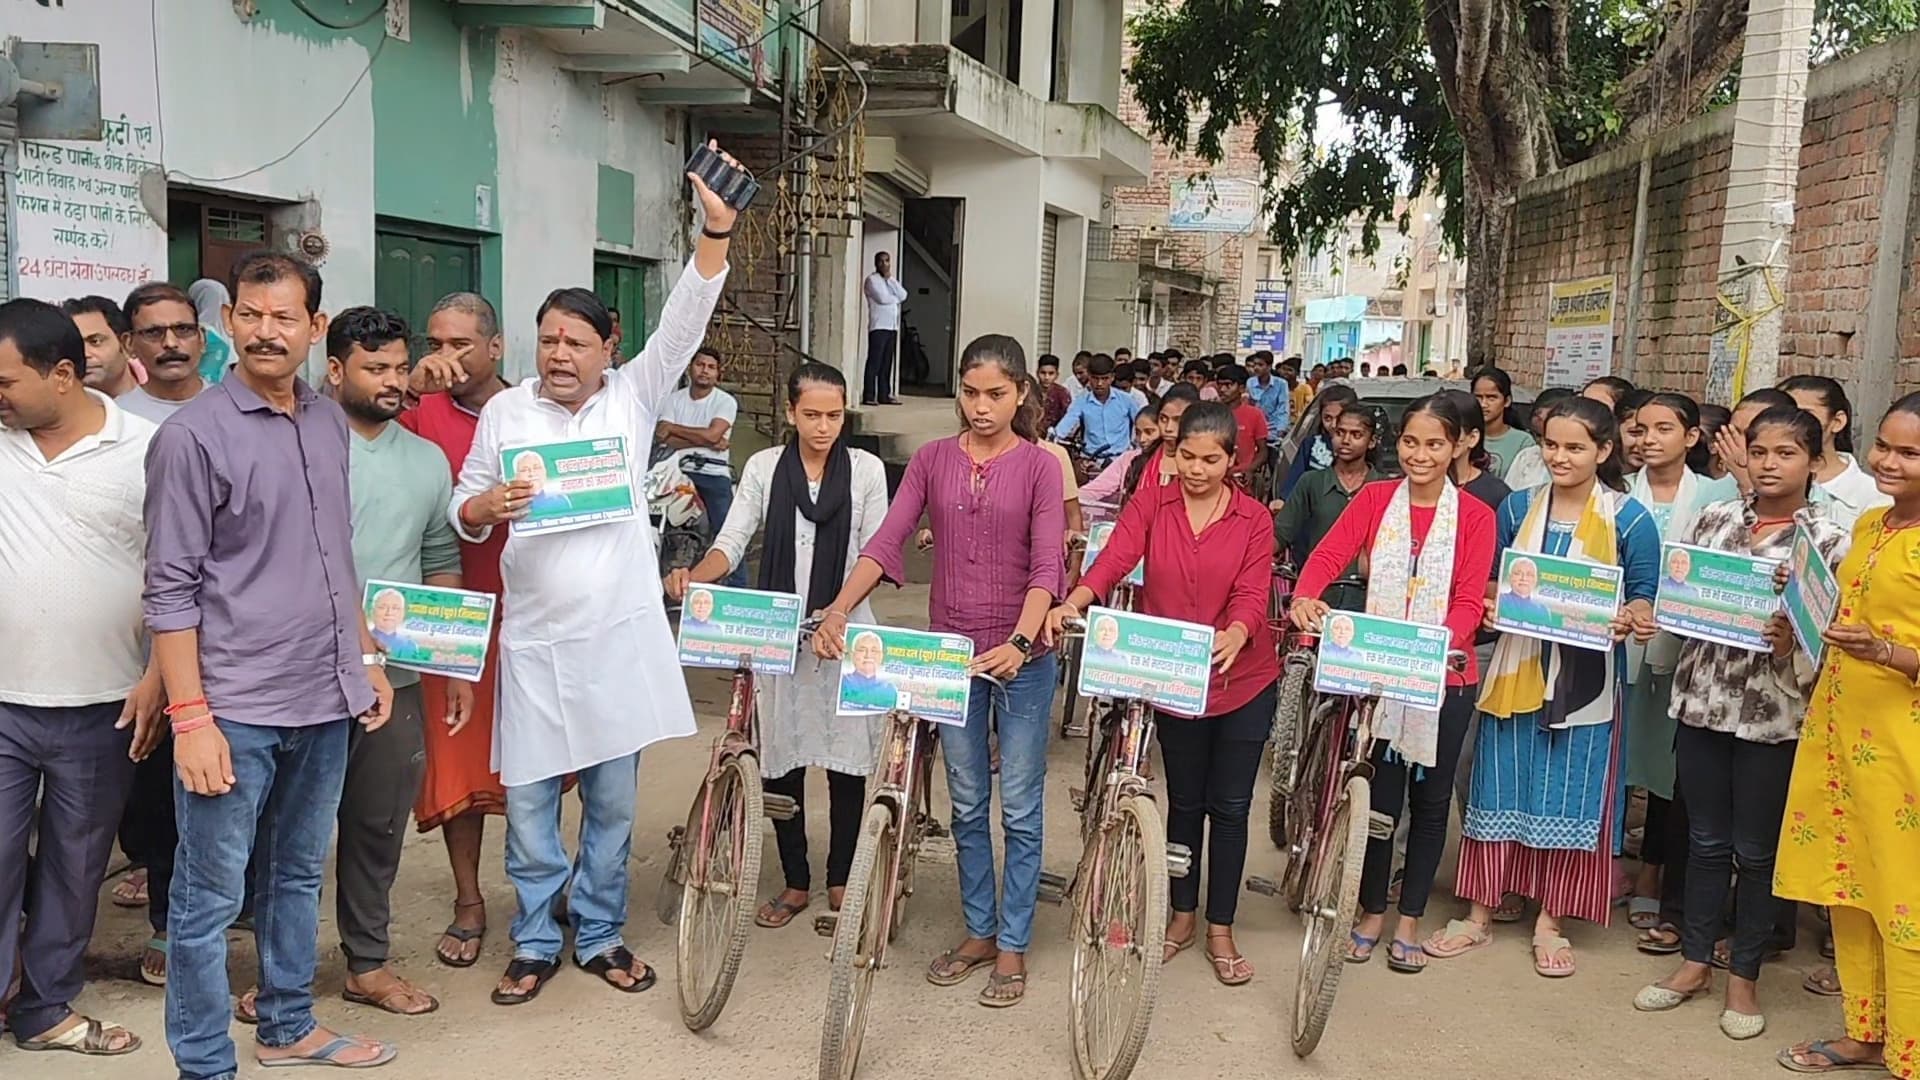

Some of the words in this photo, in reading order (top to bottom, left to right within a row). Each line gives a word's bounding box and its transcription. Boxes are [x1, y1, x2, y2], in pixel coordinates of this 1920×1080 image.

[47, 168, 76, 191] विवाह
[115, 203, 126, 225] के
[18, 256, 41, 278] 24
[70, 256, 94, 281] सेवा
[94, 263, 137, 284] उपलब्ध
